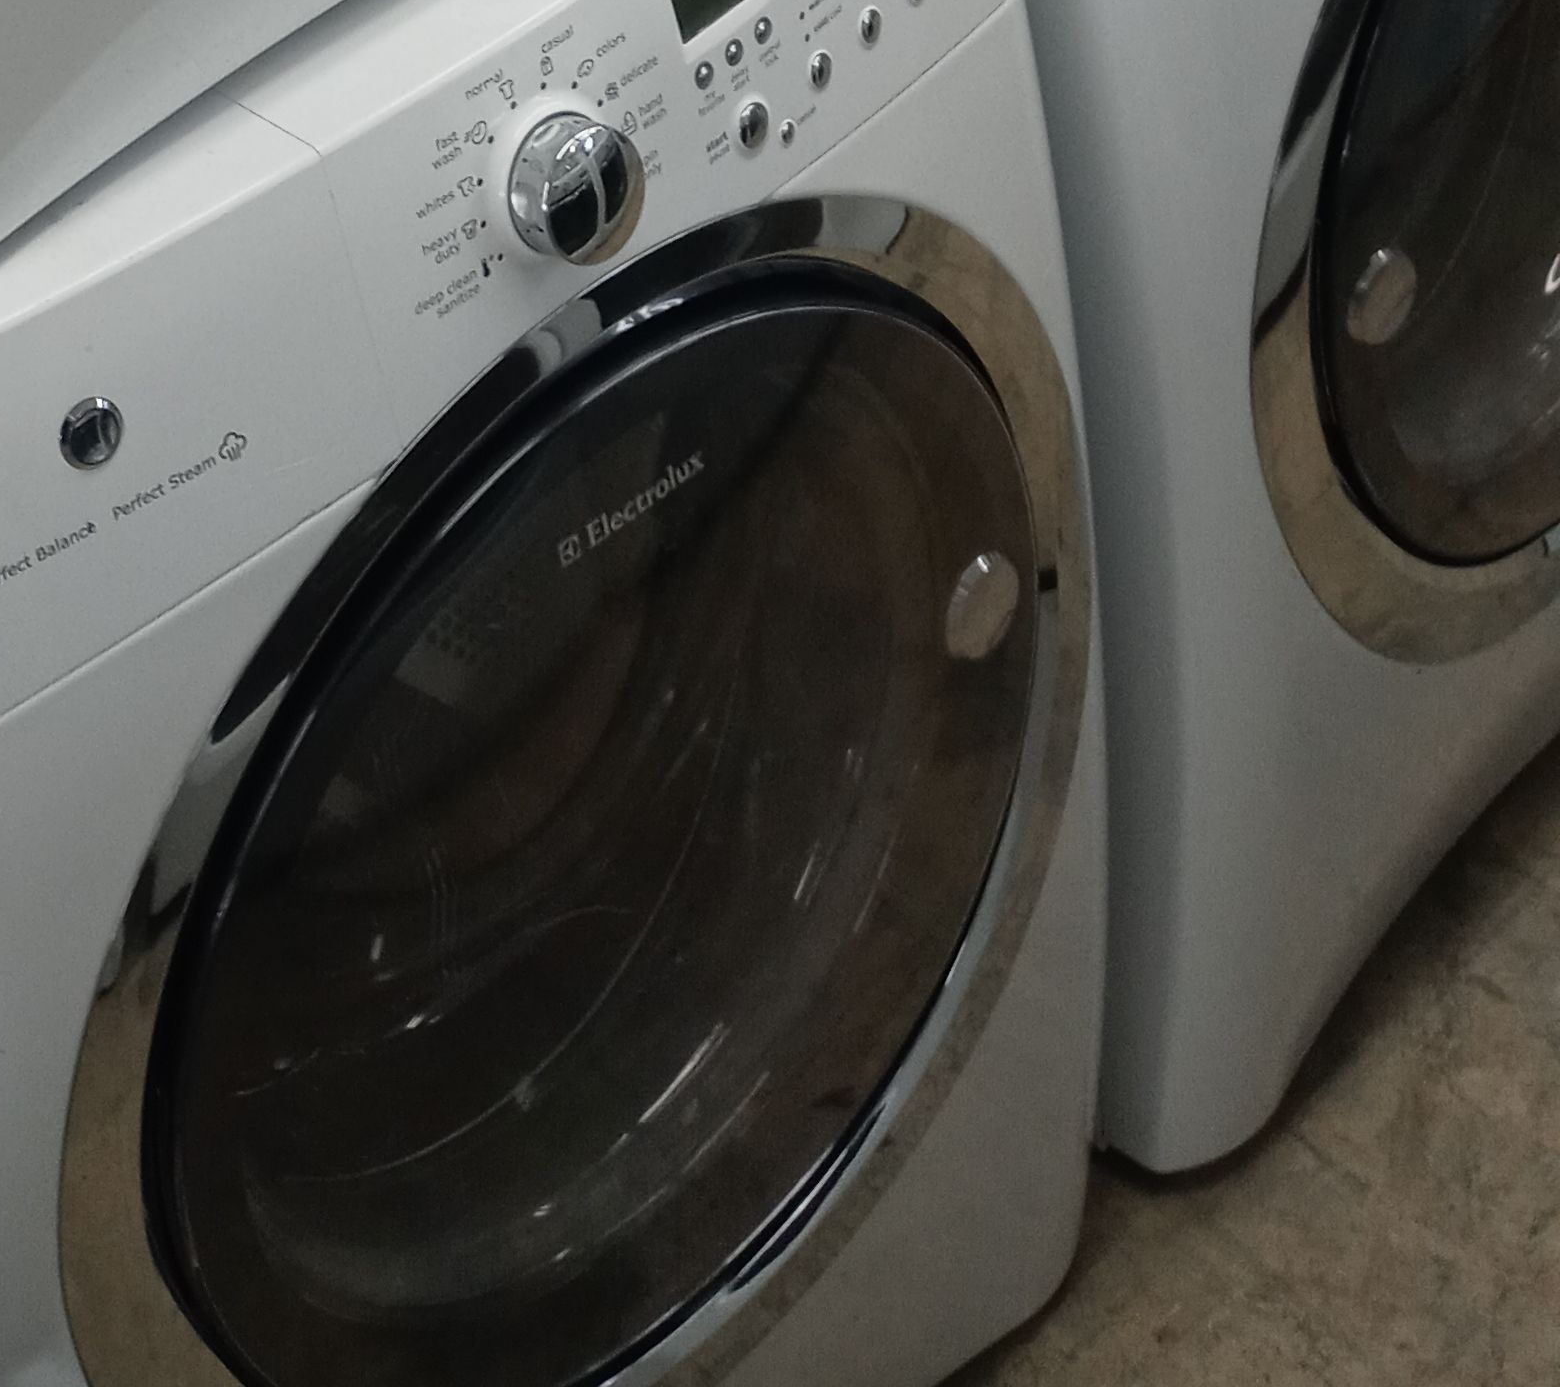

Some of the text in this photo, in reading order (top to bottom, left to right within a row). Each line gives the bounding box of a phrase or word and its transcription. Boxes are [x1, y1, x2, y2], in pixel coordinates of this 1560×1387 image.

[541, 24, 575, 55] casual
[596, 32, 628, 59] colors
[464, 68, 504, 102] normal
[620, 55, 660, 88] delicate
[435, 130, 459, 151] fast
[431, 146, 464, 170] wash
[415, 190, 456, 219] whites
[421, 228, 459, 256] heavy
[414, 269, 478, 316] deep clean
[435, 283, 482, 319] sanitize
[35, 521, 98, 563] Balance
[111, 483, 166, 521] Perfect
[167, 454, 218, 491] Steam
[586, 451, 705, 549] Electrolux
